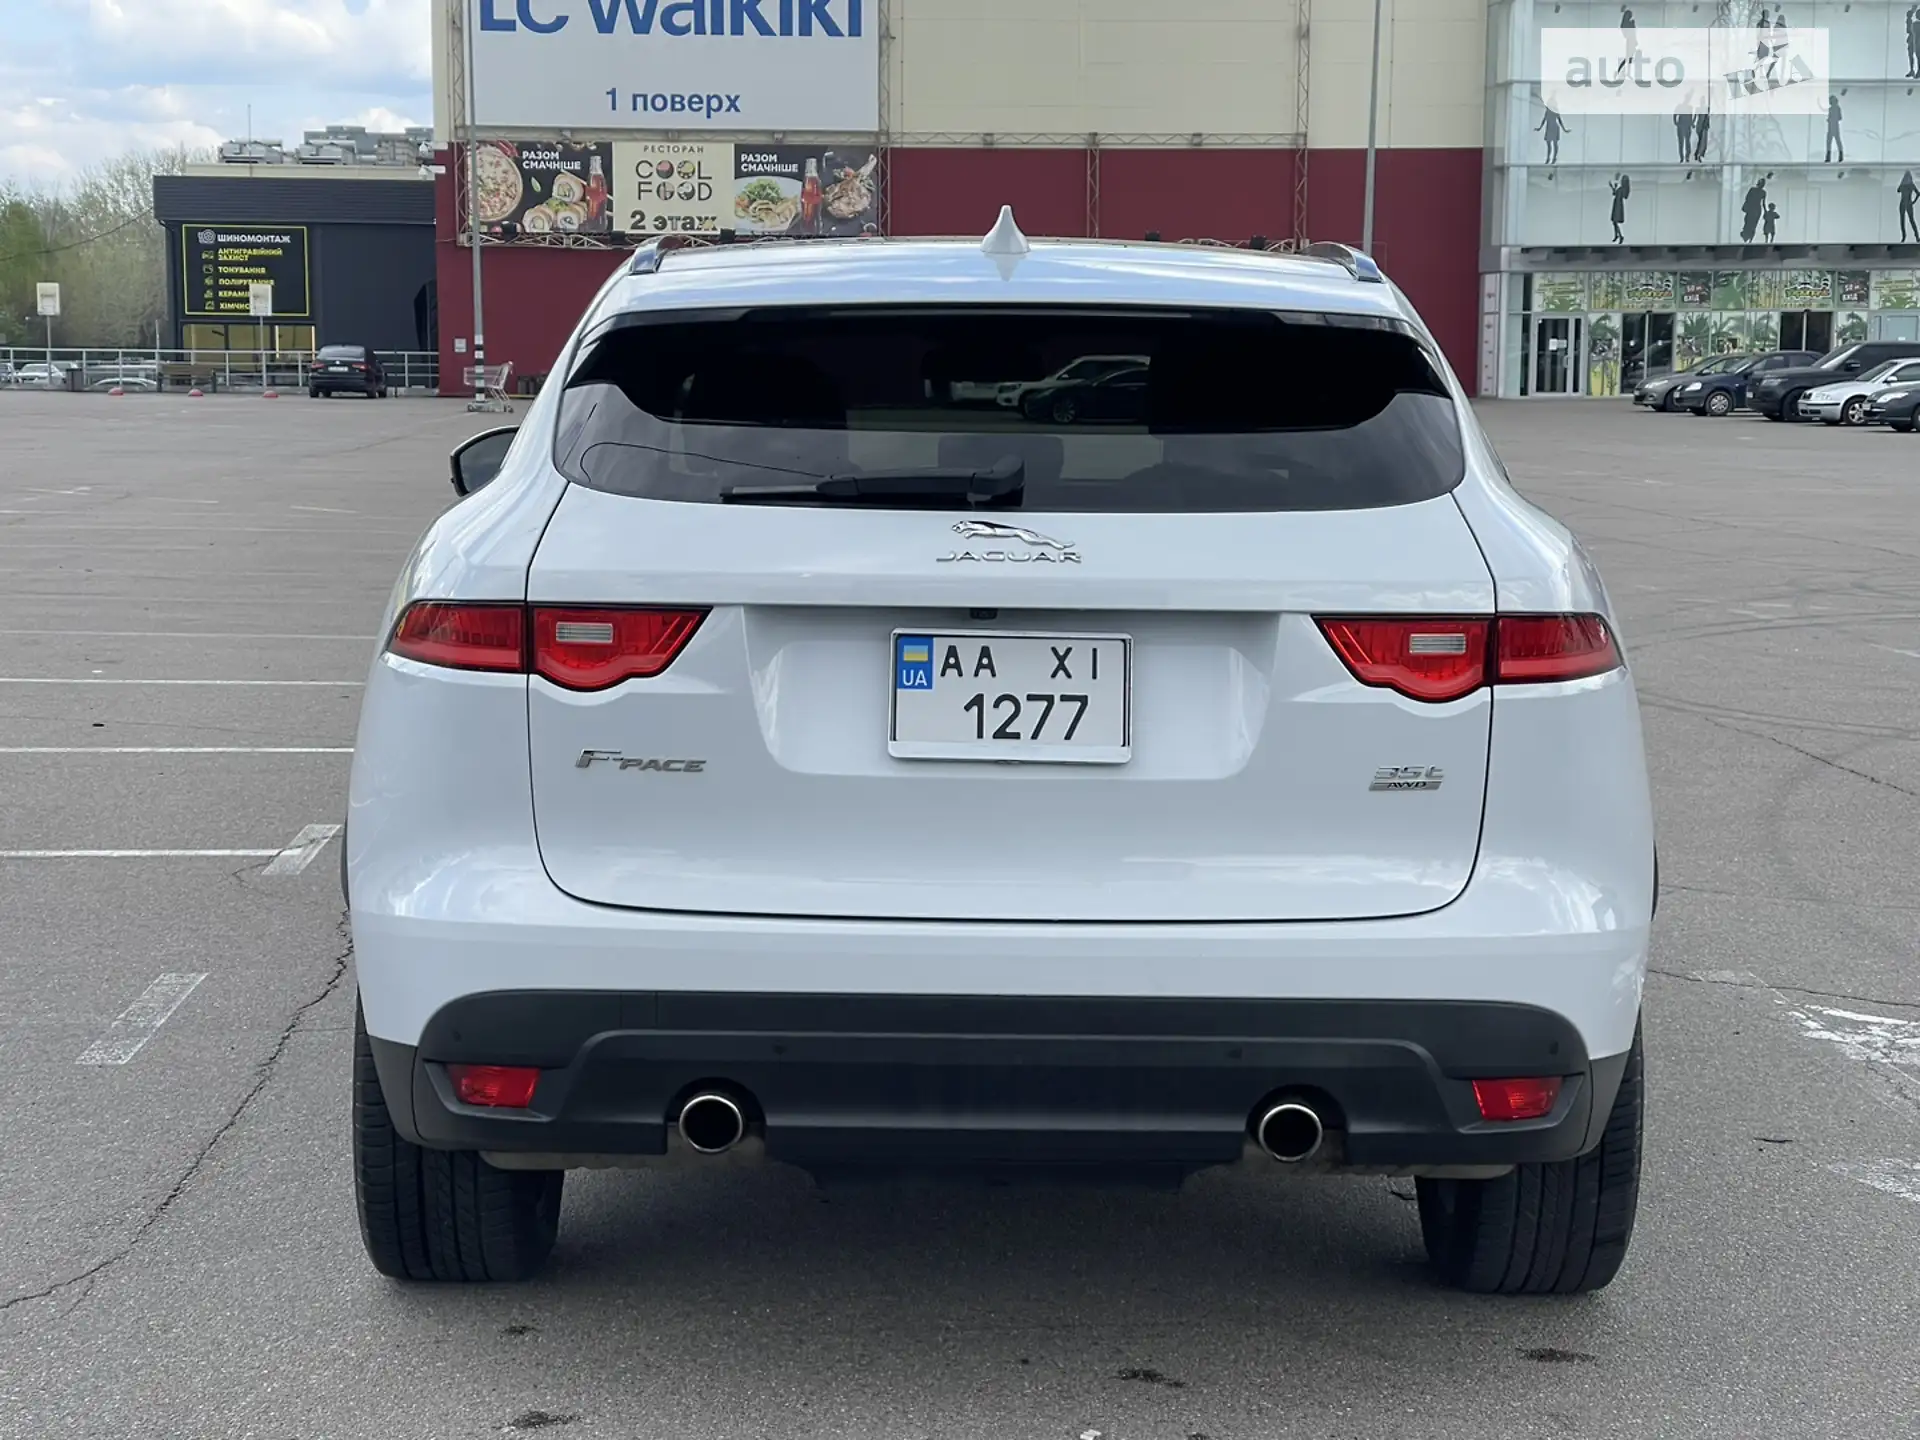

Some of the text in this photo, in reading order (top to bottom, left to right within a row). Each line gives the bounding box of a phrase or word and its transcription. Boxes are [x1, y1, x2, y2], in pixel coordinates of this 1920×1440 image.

[605, 88, 741, 118] 1 поверх
[522, 151, 560, 160] РАЗОМ
[643, 145, 704, 154] РЕСТОРАН
[740, 154, 778, 163] РАЗОМ
[522, 161, 581, 170] СМАЧНІШЕ
[635, 160, 713, 180] COOL
[740, 163, 799, 172] СМАЧНІШЕ
[637, 181, 713, 201] FOOD
[630, 210, 718, 231] 2 этаж
[217, 234, 291, 243] ШИНОМОНТАЖ
[218, 266, 266, 274] ТОНУВАННЯ
[936, 551, 1082, 564] JAGUAR
[940, 645, 997, 677] AA
[902, 670, 928, 687] UA
[963, 693, 1089, 740] 1277
